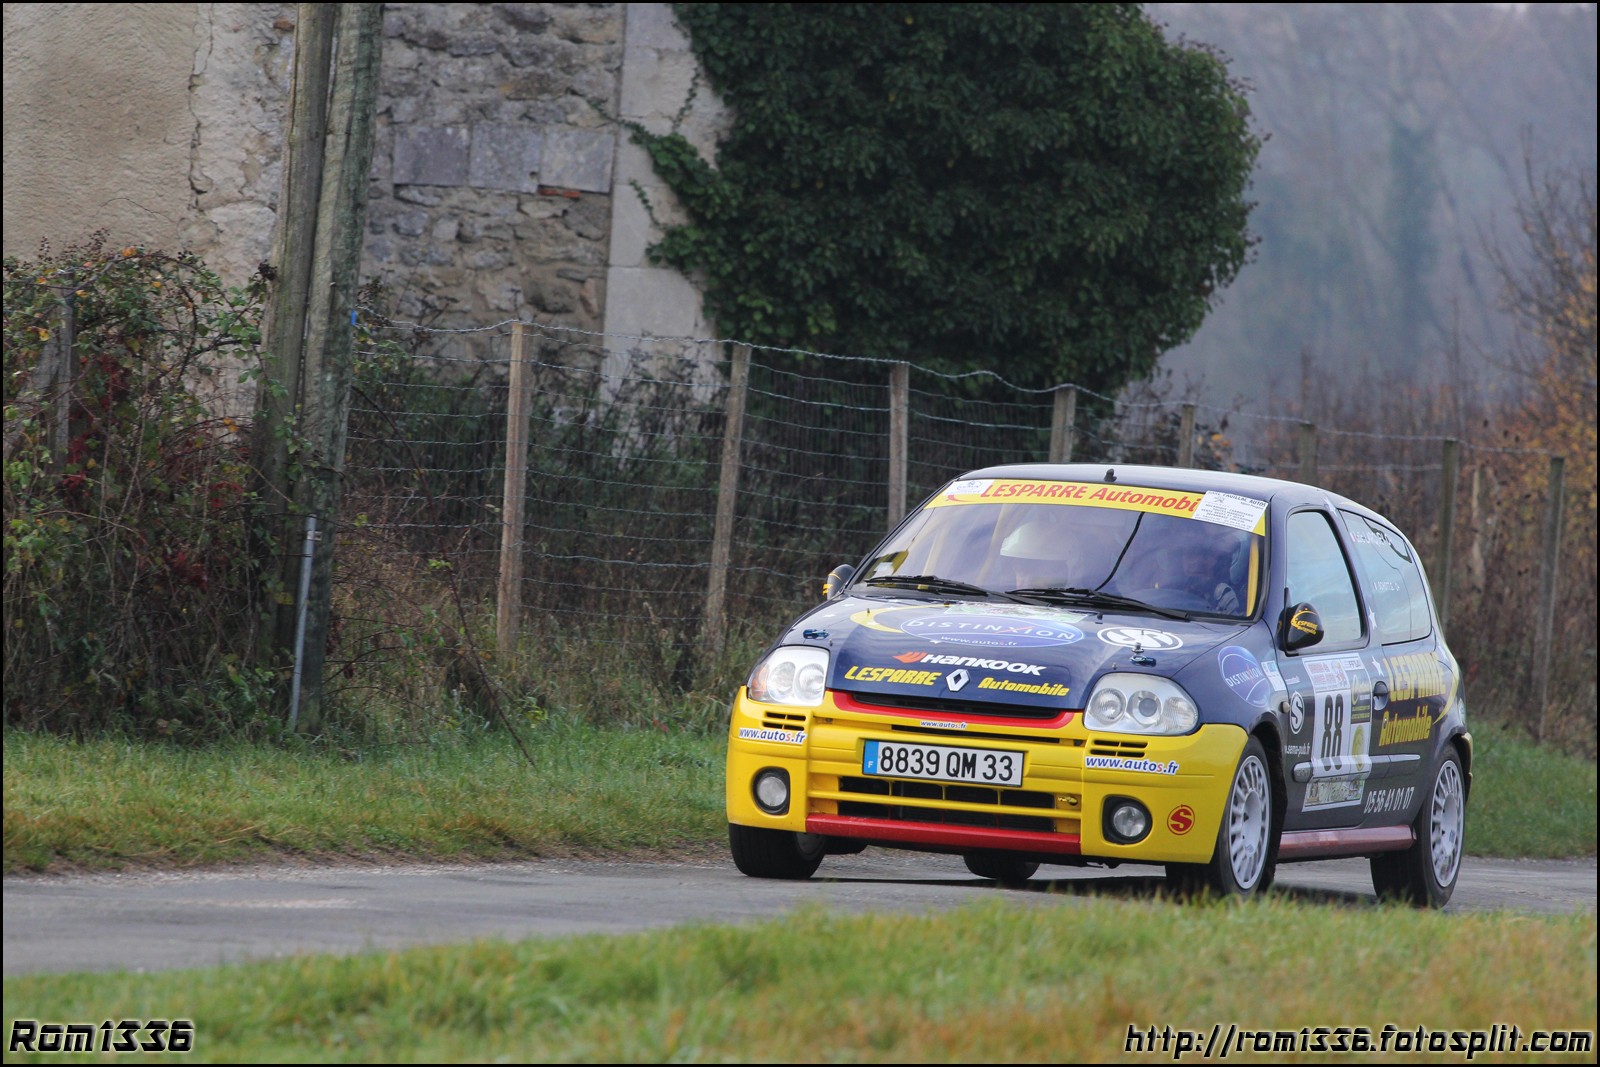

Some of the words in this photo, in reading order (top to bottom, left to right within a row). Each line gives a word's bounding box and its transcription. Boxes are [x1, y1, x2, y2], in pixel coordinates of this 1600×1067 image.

[980, 484, 1088, 499] LESPARRE
[1089, 487, 1201, 512] Automobi
[906, 621, 1075, 640] DISTINXION
[941, 636, 1018, 646] www.autos.fr
[844, 666, 942, 686] LESPARRE
[977, 677, 1070, 697] Automobile
[739, 728, 806, 743] www.autos.fr
[920, 719, 967, 729] www.autos.fr
[1320, 693, 1344, 772] 88
[1379, 705, 1432, 747] Automobile
[867, 760, 874, 769] F
[880, 746, 940, 776] 8839
[946, 751, 977, 778] QM
[982, 754, 1013, 781] 33
[1086, 757, 1178, 774] www.autos.fr
[1363, 790, 1377, 814] 05
[1373, 789, 1386, 813] 56
[1384, 788, 1396, 812] 41
[1392, 787, 1405, 811] 01
[1402, 786, 1415, 810] 07
